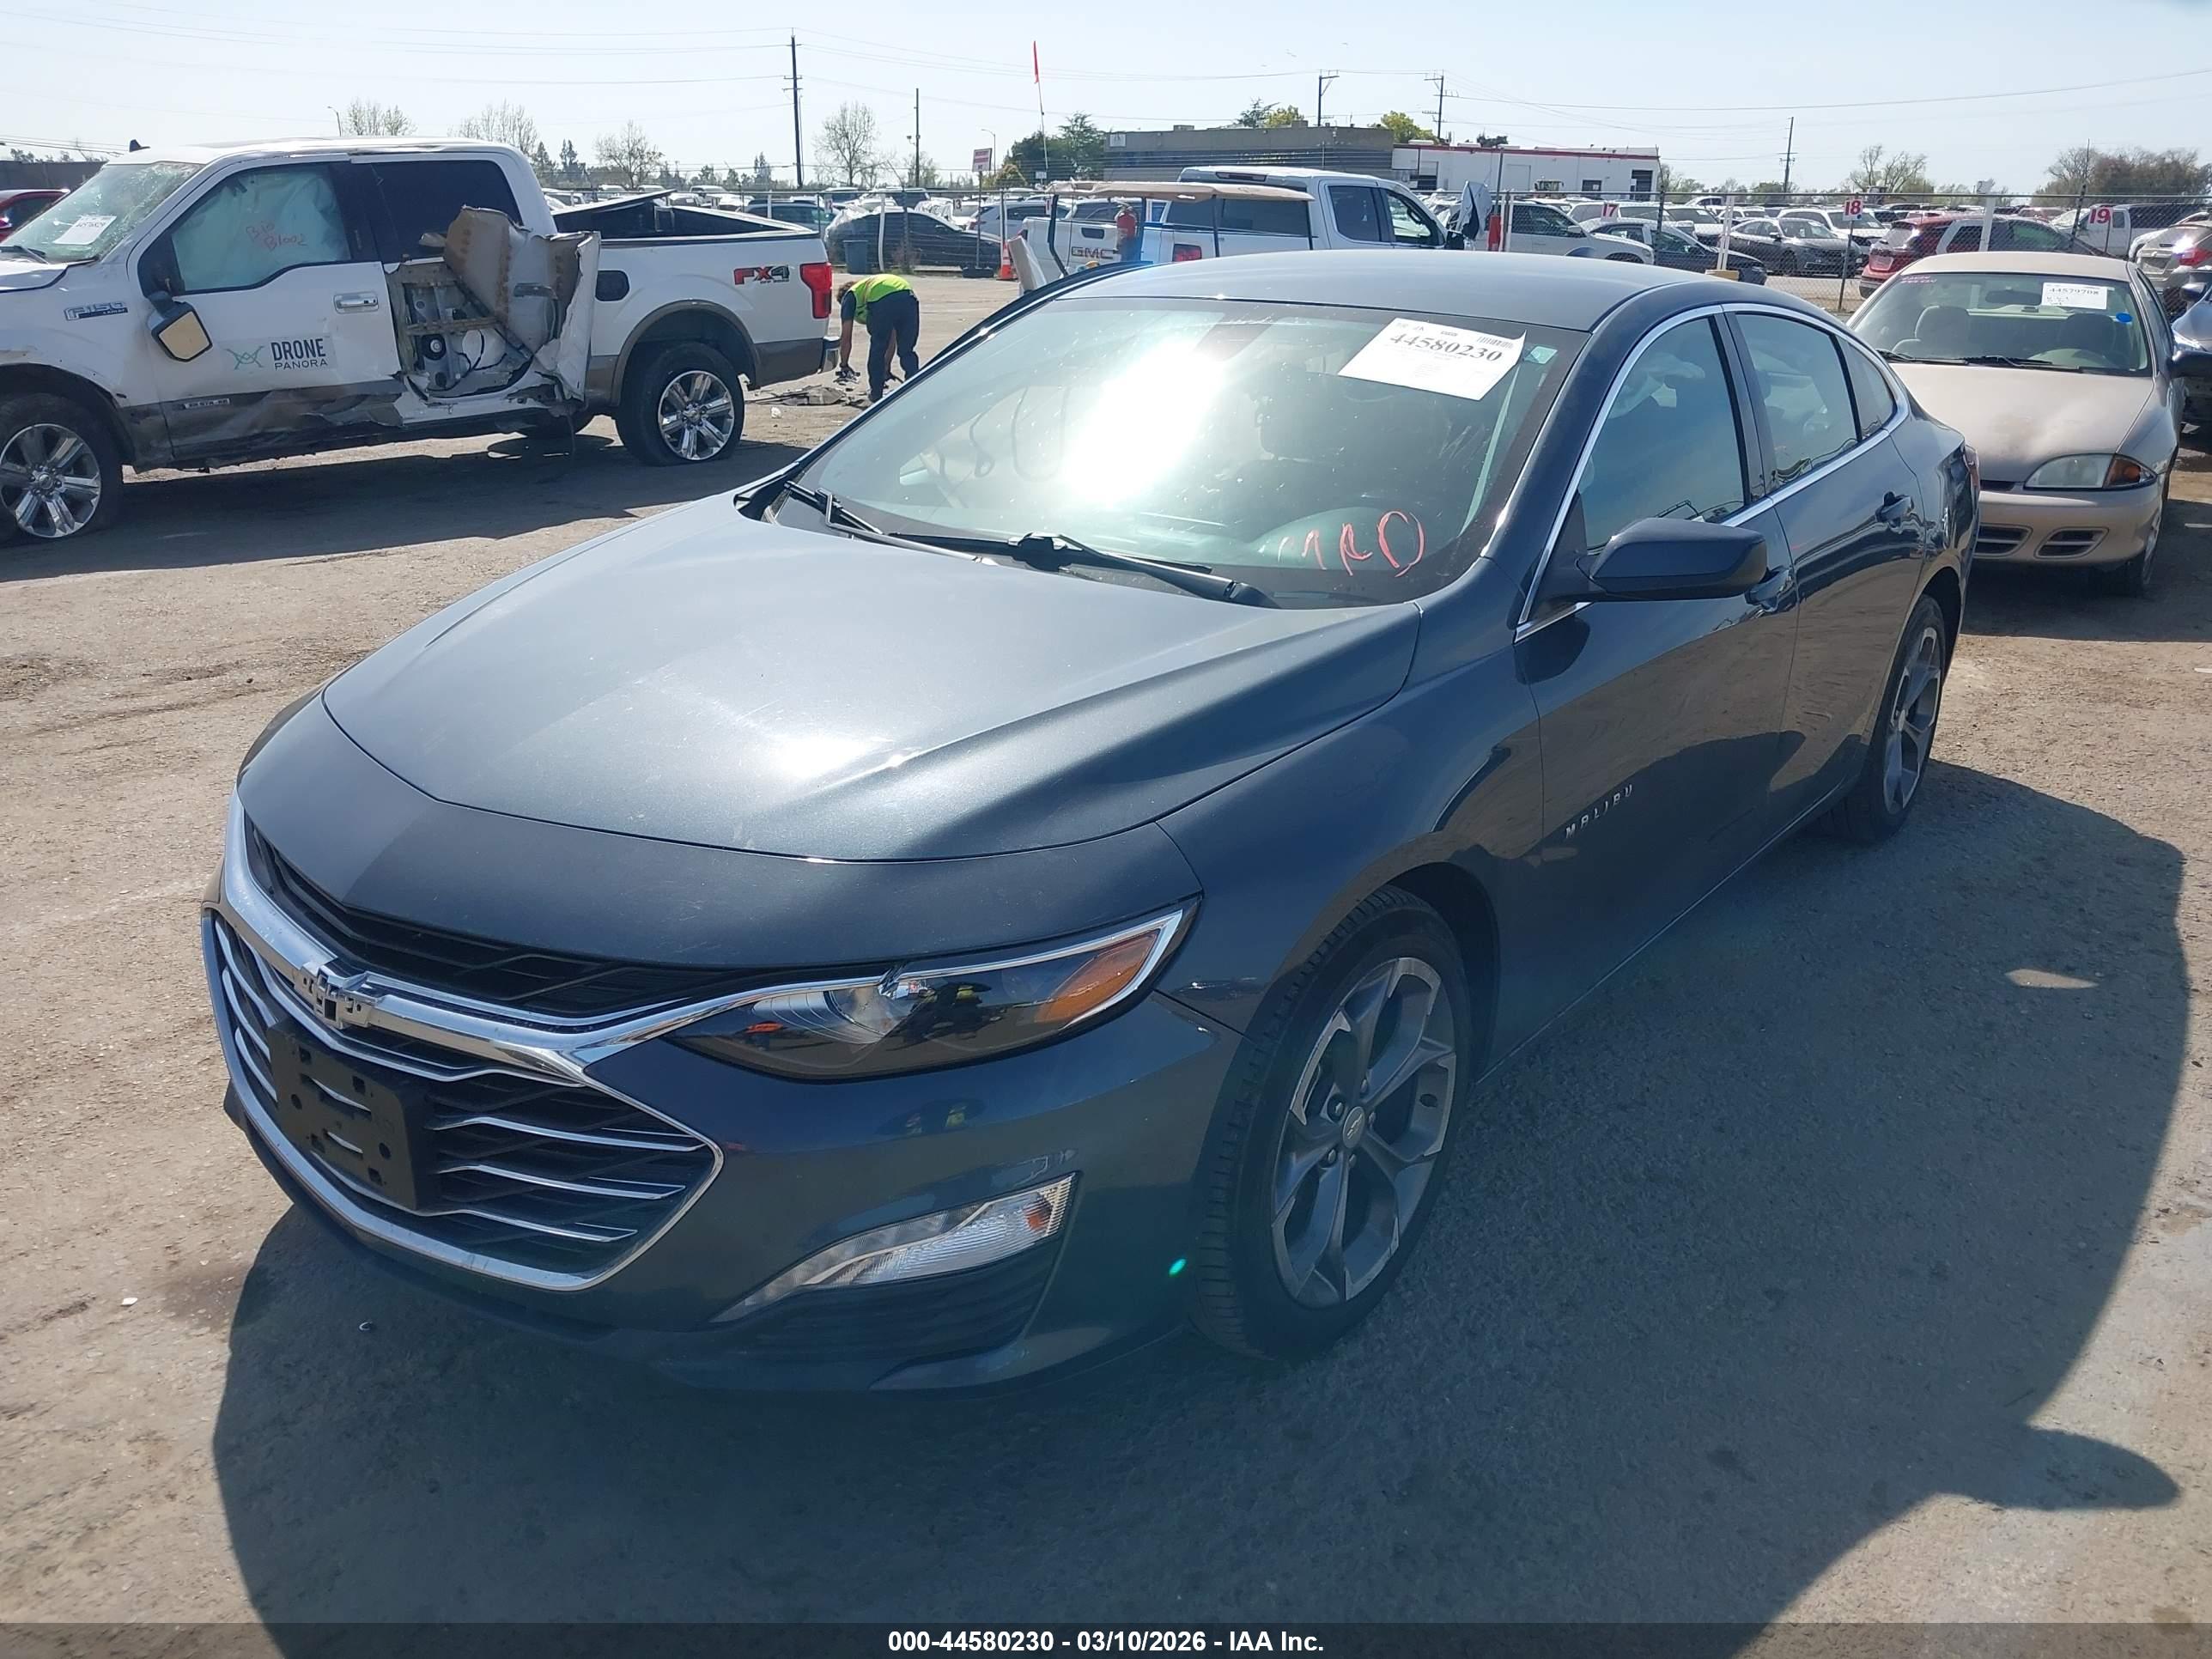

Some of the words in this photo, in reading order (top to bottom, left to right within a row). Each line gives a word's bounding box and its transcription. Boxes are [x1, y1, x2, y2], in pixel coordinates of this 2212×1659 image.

[1602, 204, 1618, 217] 17
[1844, 200, 1862, 216] 18
[2089, 208, 2112, 224] 19
[1071, 246, 1114, 259] GMC
[733, 264, 790, 285] FX4
[270, 338, 326, 361] DRONE
[1389, 332, 1503, 362] 44580230
[274, 358, 328, 370] PANORA
[1565, 783, 1633, 839] MALIBU
